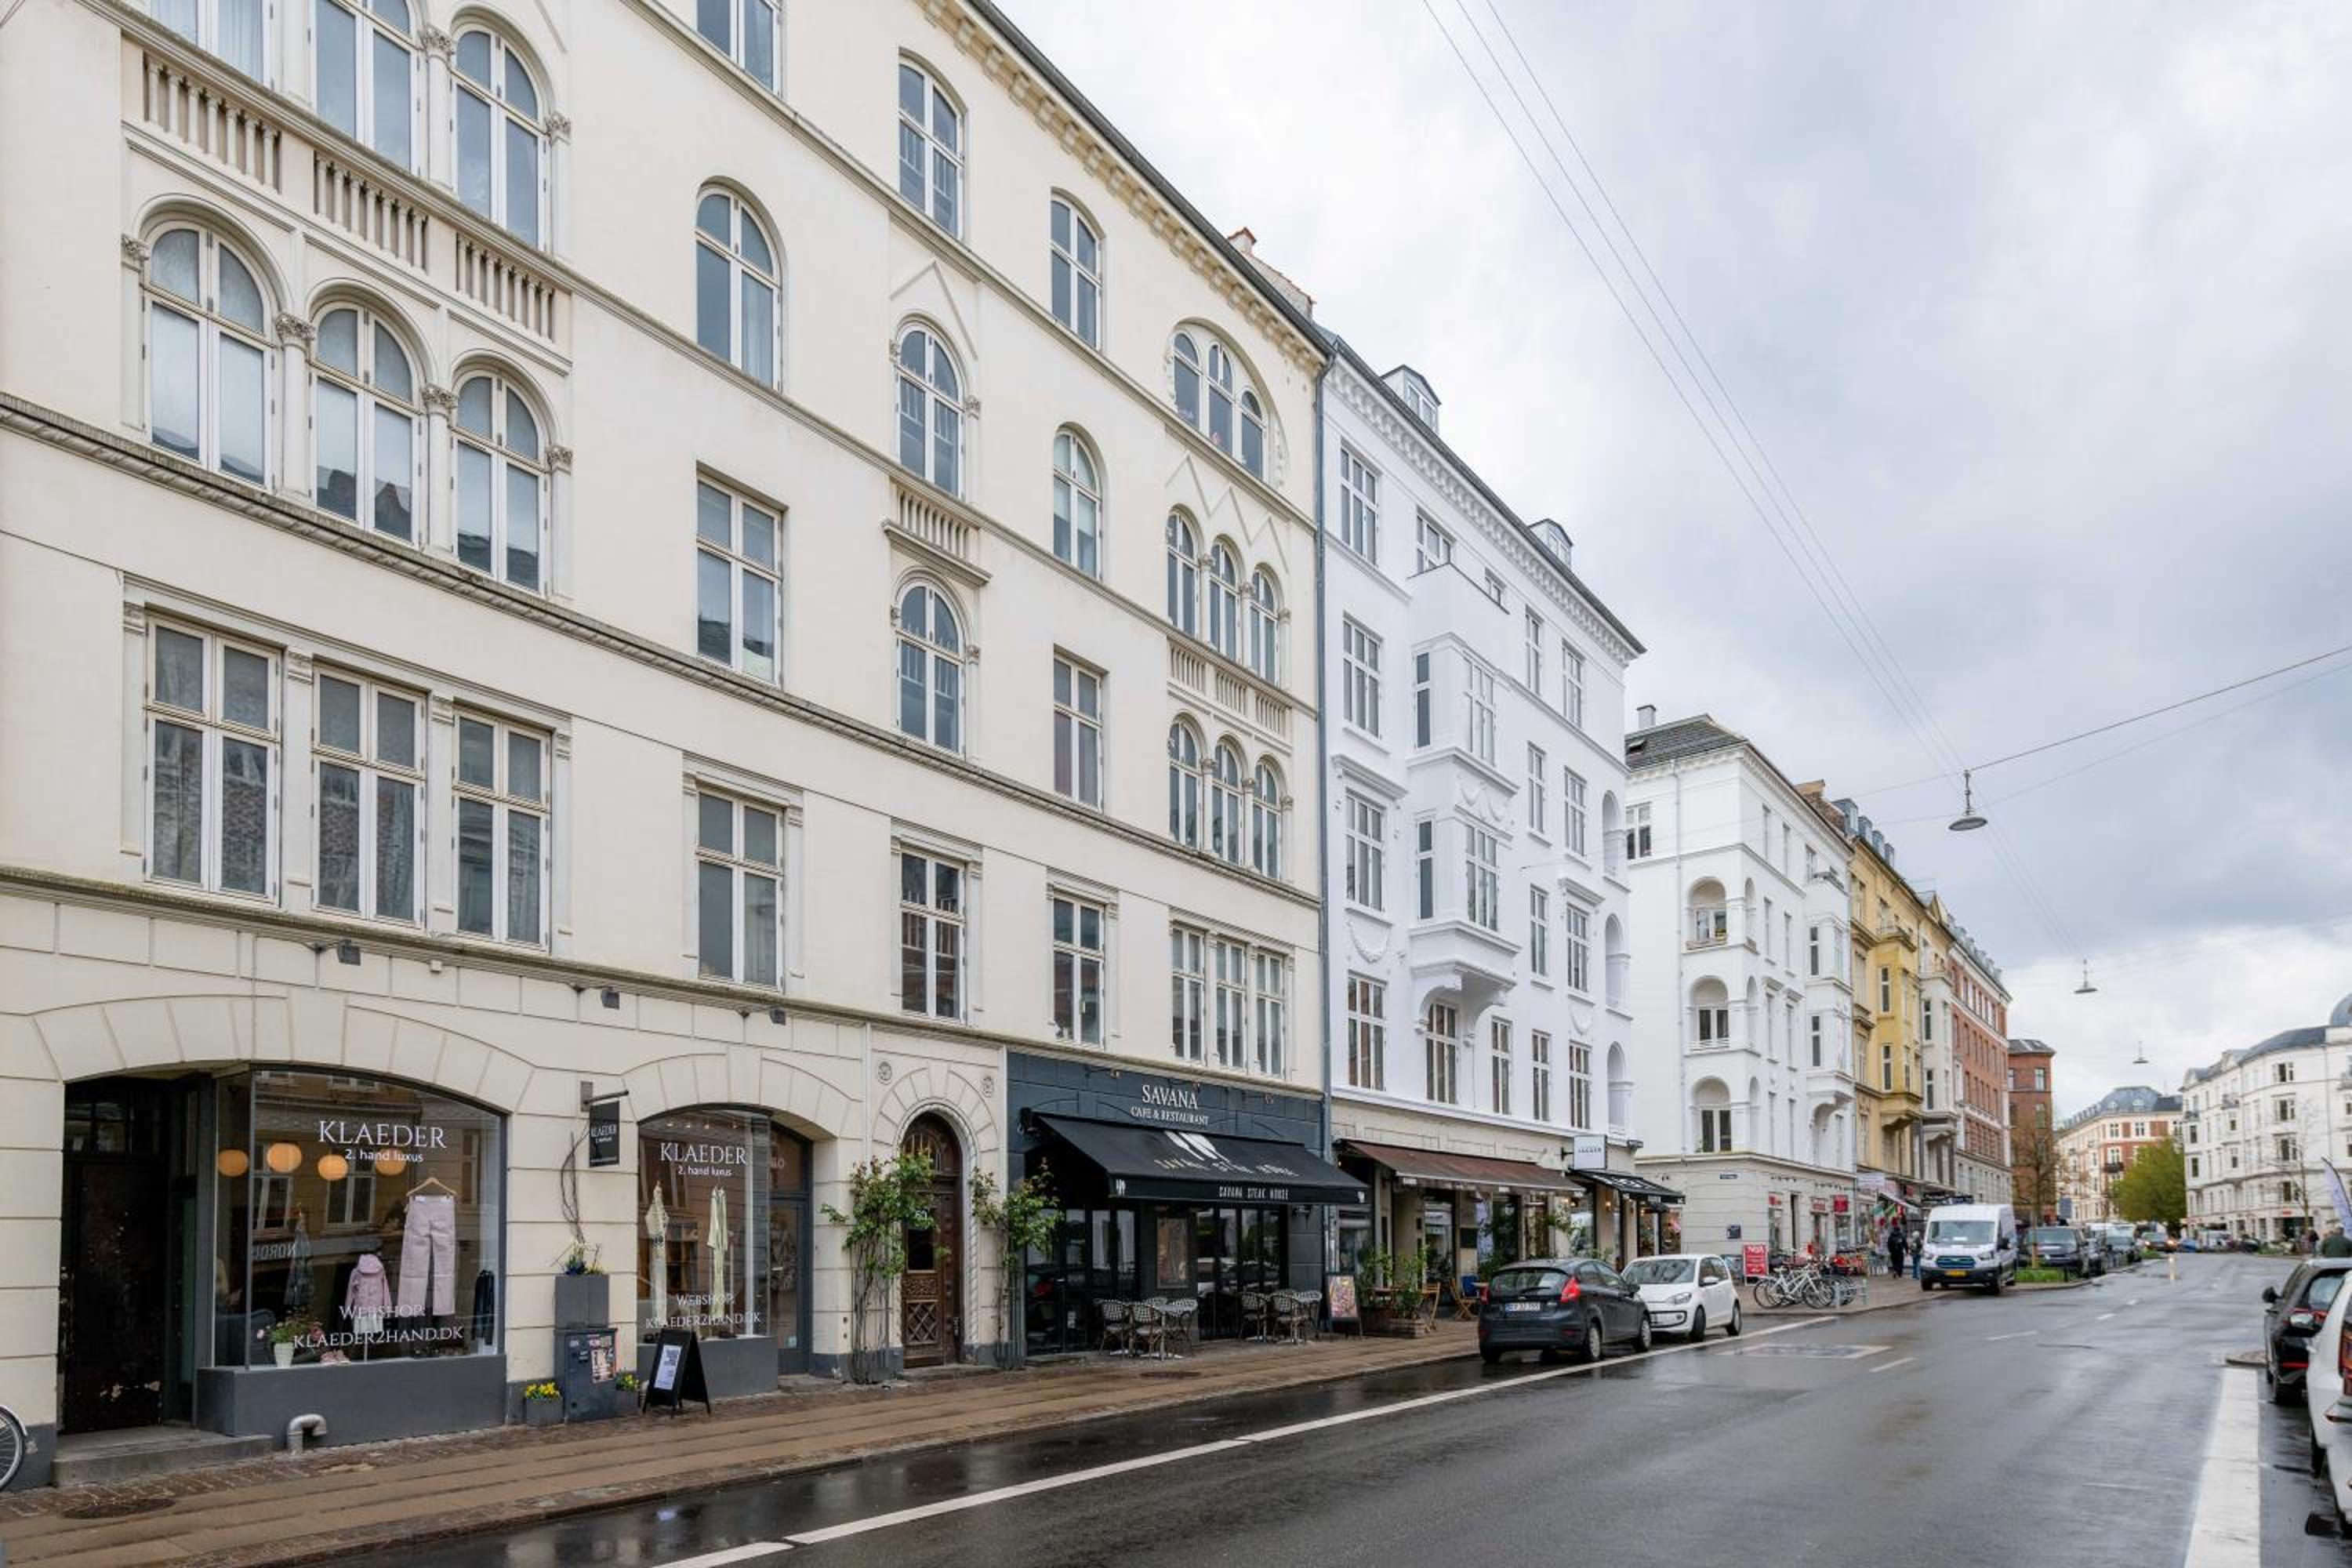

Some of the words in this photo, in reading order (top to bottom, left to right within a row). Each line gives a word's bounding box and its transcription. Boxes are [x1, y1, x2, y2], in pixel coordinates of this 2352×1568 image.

[1142, 1084, 1199, 1109] SAVANA
[1161, 1109, 1209, 1126] RESTAURANT
[318, 1120, 448, 1149] KLAEDER
[360, 1149, 390, 1162] hand
[394, 1151, 424, 1163] luxus
[660, 1142, 747, 1165] KLAEDER
[688, 1166, 710, 1177] hand
[711, 1167, 732, 1178] luxus
[293, 1326, 465, 1349] KLAEDER2HAND.DK
